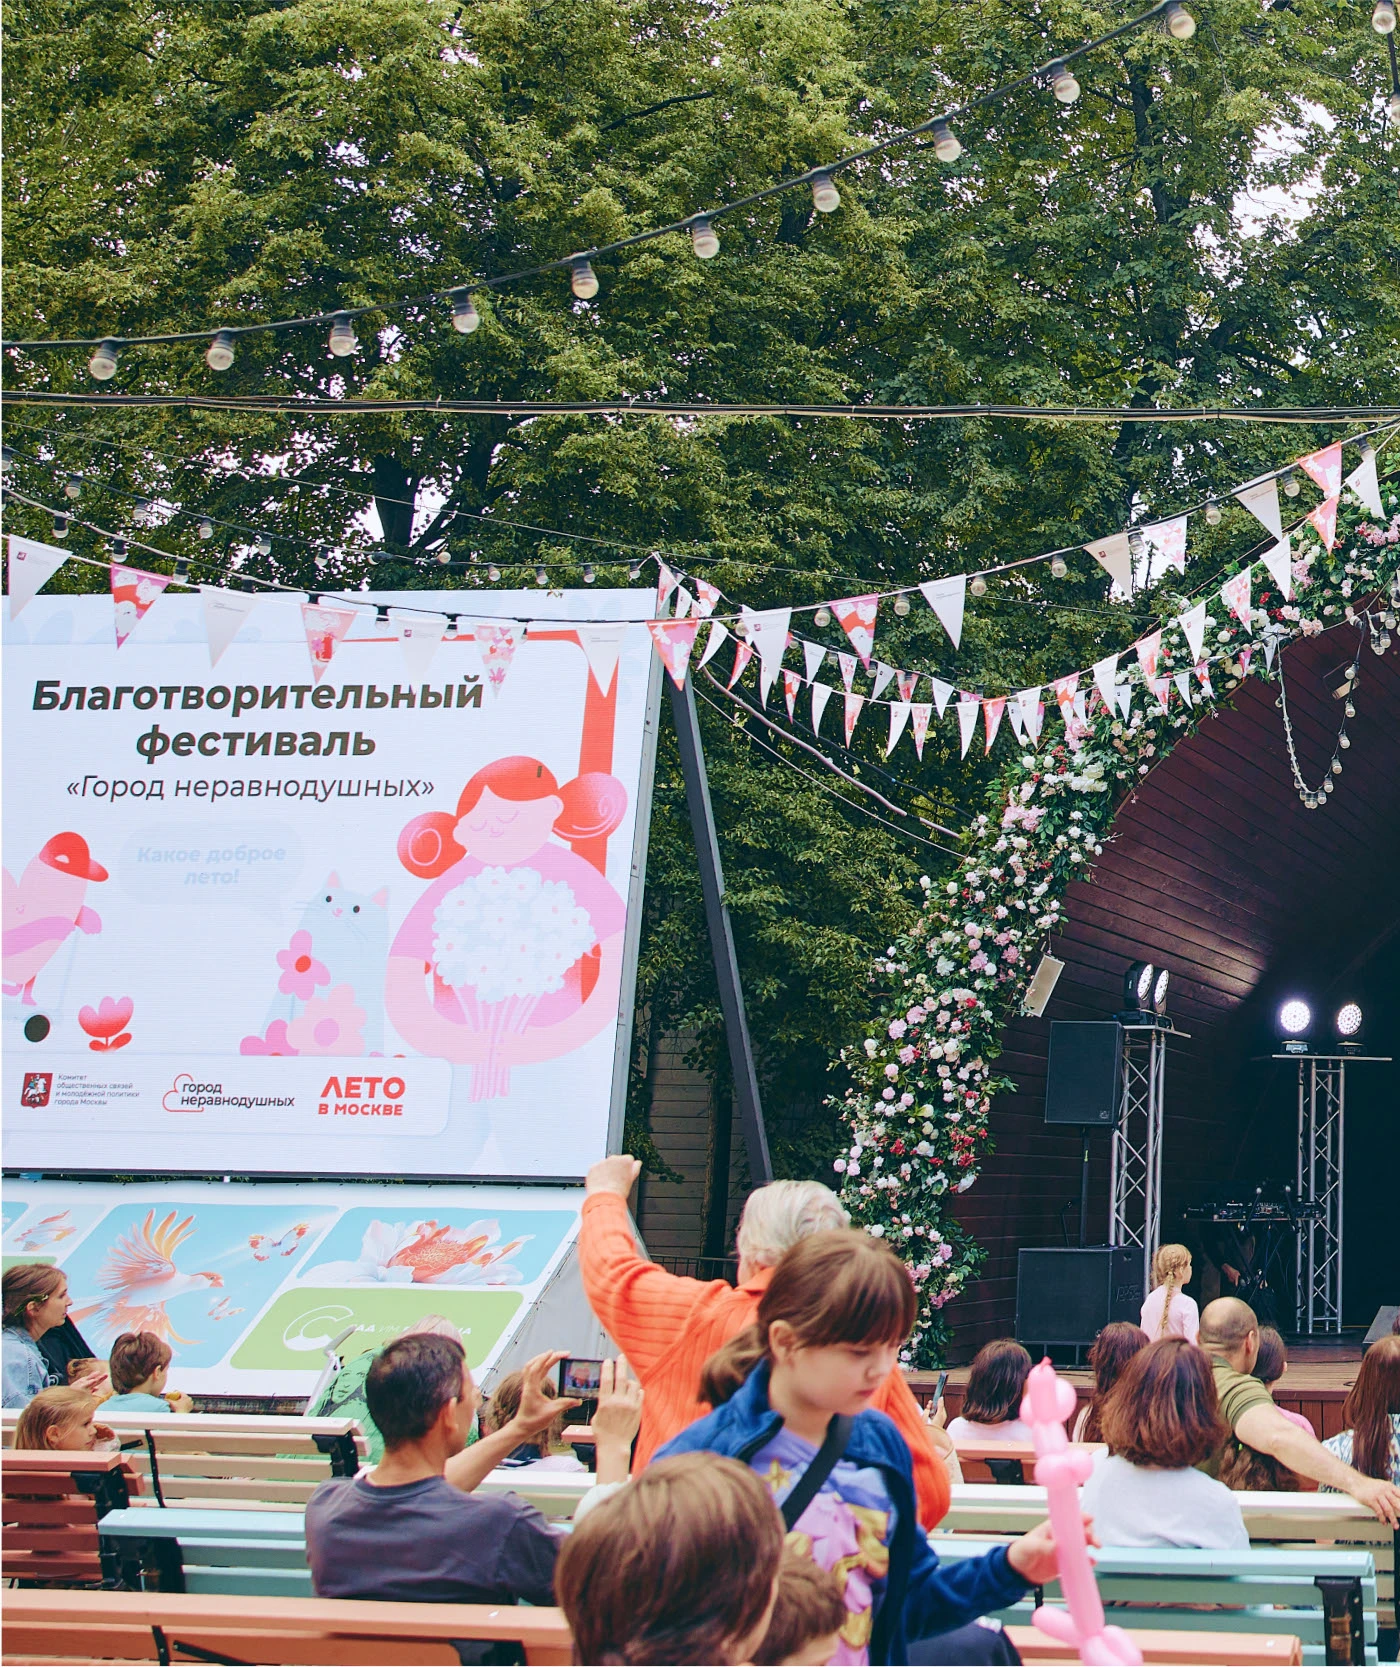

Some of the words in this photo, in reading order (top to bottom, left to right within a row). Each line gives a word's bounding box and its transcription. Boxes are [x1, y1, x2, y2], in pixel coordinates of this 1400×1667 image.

[32, 674, 483, 717] Благотворительный
[136, 725, 376, 764] фестиваль
[66, 775, 164, 800] «Город
[174, 777, 435, 802] неравнодушных»
[137, 848, 200, 863] Какое
[206, 845, 287, 864] доброе
[184, 869, 240, 885] лето!
[183, 1082, 222, 1095] город
[320, 1076, 406, 1100] ЛЕТО
[181, 1096, 295, 1109] неравнодушных
[318, 1103, 328, 1115] В
[334, 1103, 404, 1116] МОСКВЕ
